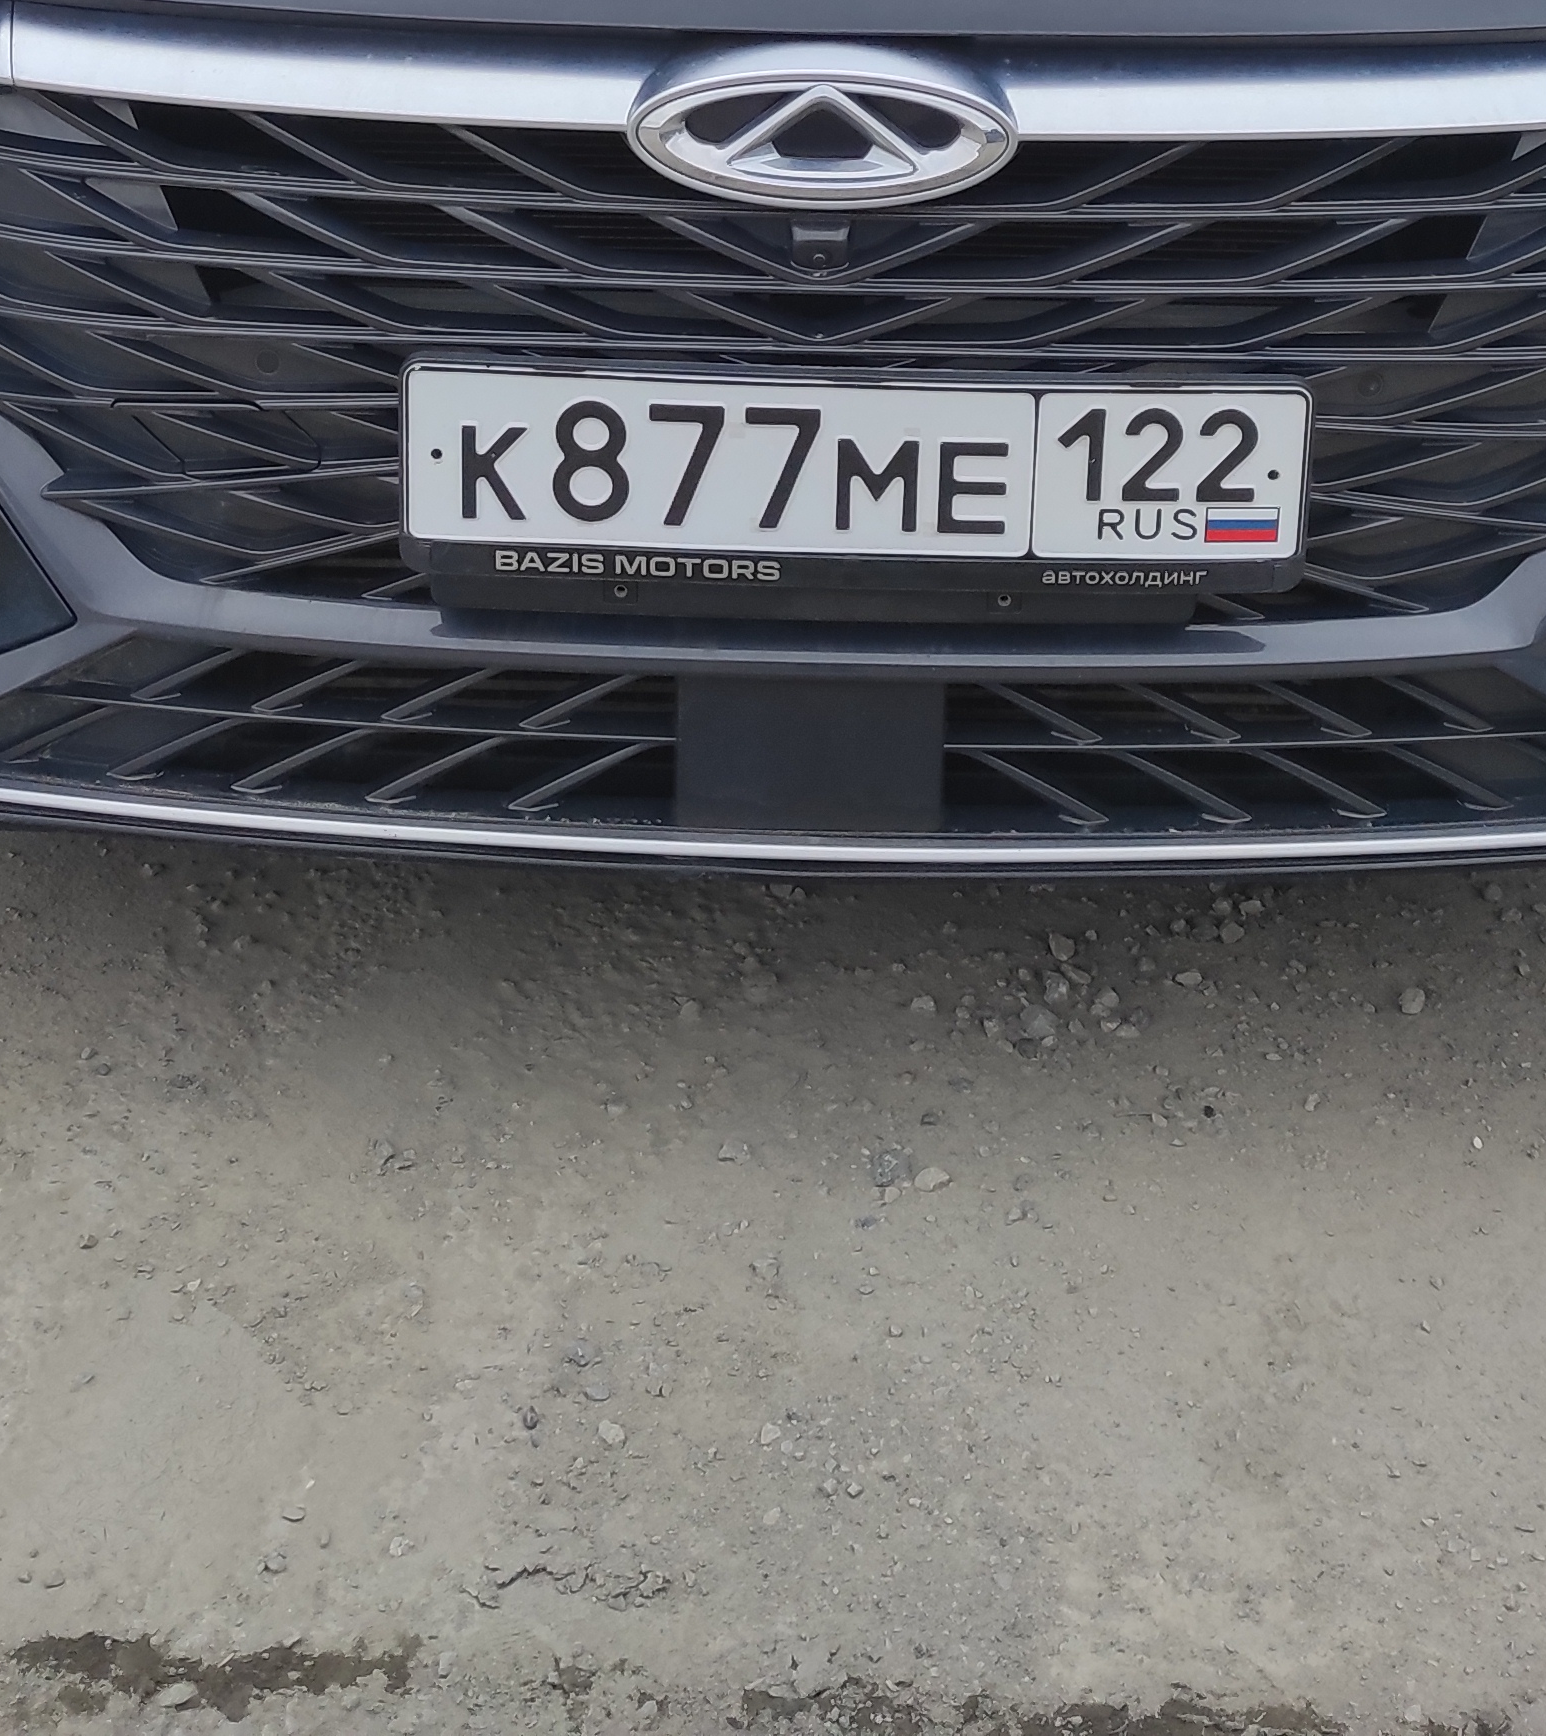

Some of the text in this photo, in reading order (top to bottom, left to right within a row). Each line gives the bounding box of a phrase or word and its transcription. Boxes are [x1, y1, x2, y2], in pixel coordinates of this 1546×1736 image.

[1057, 407, 1259, 503] 122
[1097, 508, 1198, 541] RUS
[495, 549, 782, 582] BAZIS MOTORS
[1041, 569, 1208, 588] автохолдинг
